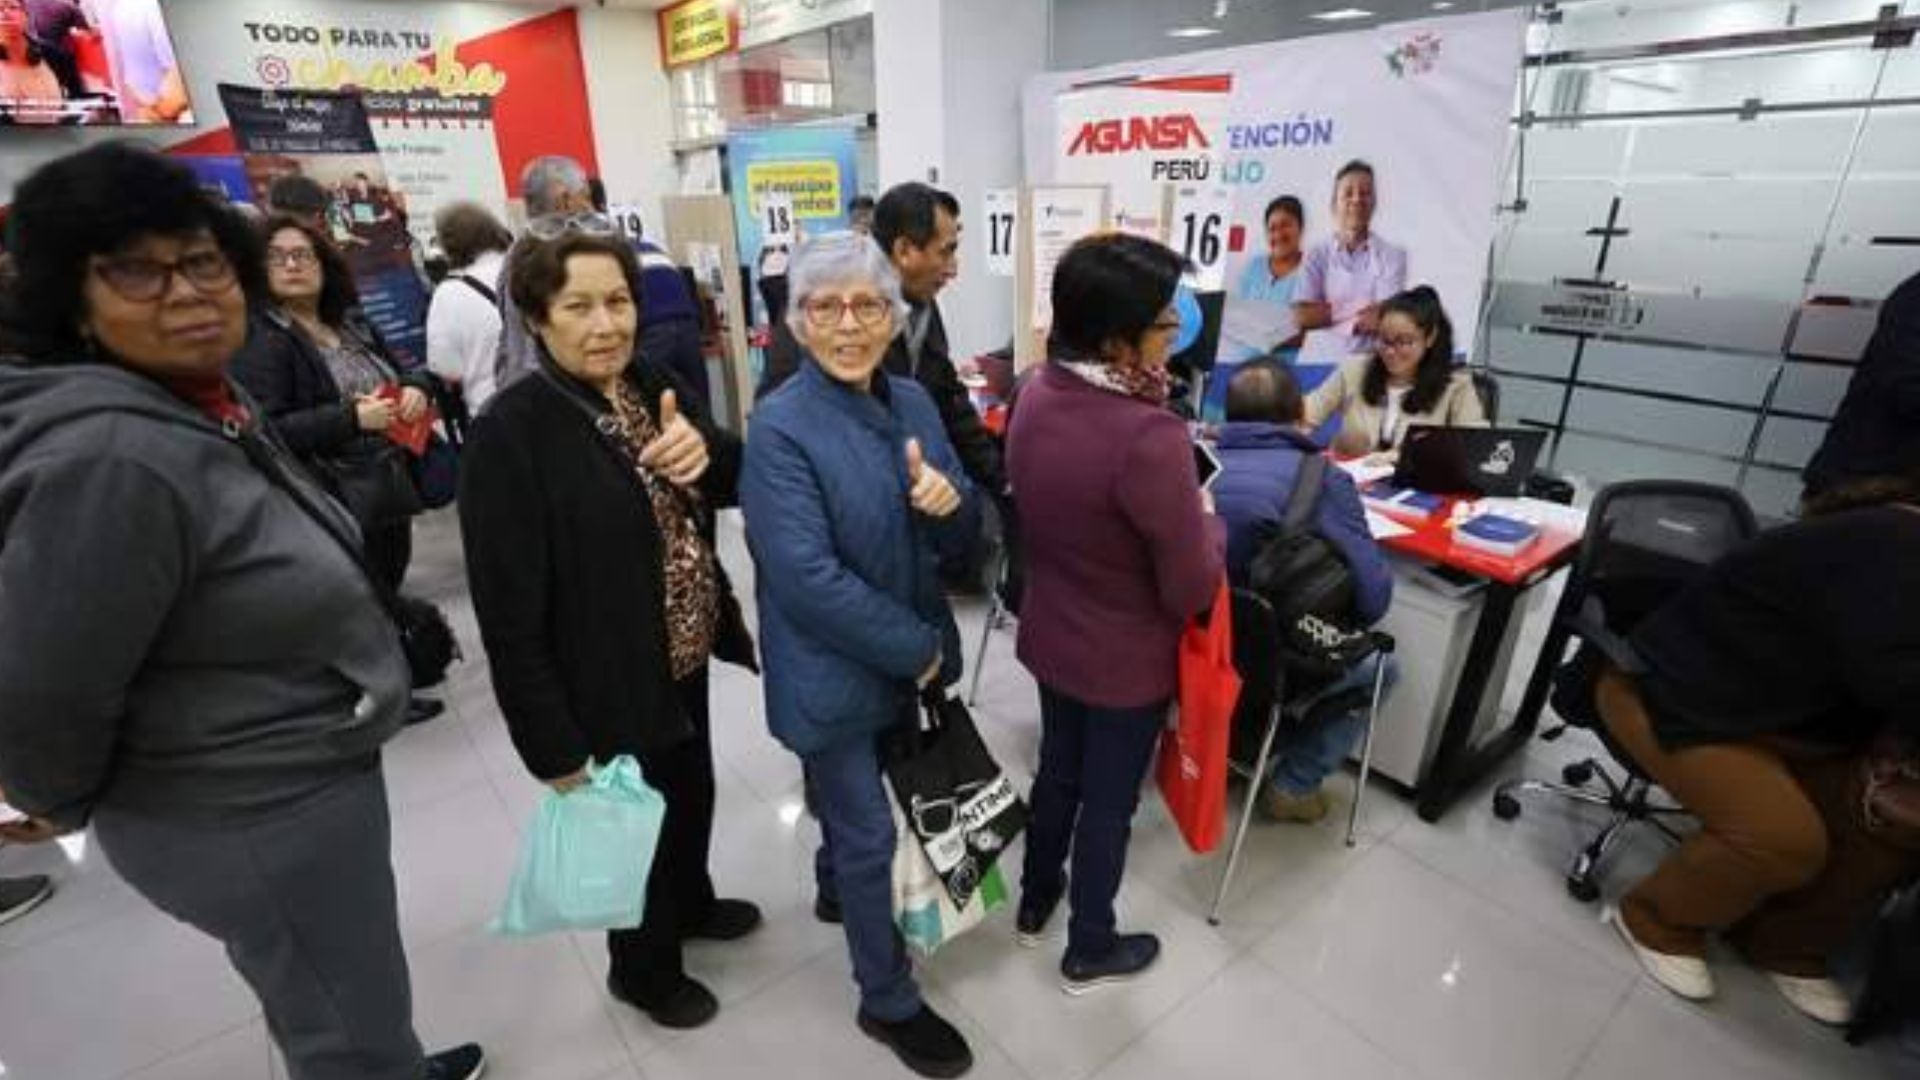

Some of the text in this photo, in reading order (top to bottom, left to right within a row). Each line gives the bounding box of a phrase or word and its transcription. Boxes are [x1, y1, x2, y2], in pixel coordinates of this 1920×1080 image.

[244, 23, 431, 49] TODO PARA TU
[1068, 114, 1210, 156] AGUNSA
[1227, 114, 1333, 149] ENCIÓN
[1152, 154, 1210, 181] PERÚ
[767, 205, 790, 234] 18
[989, 212, 1015, 255] 17
[1183, 212, 1222, 267] 16
